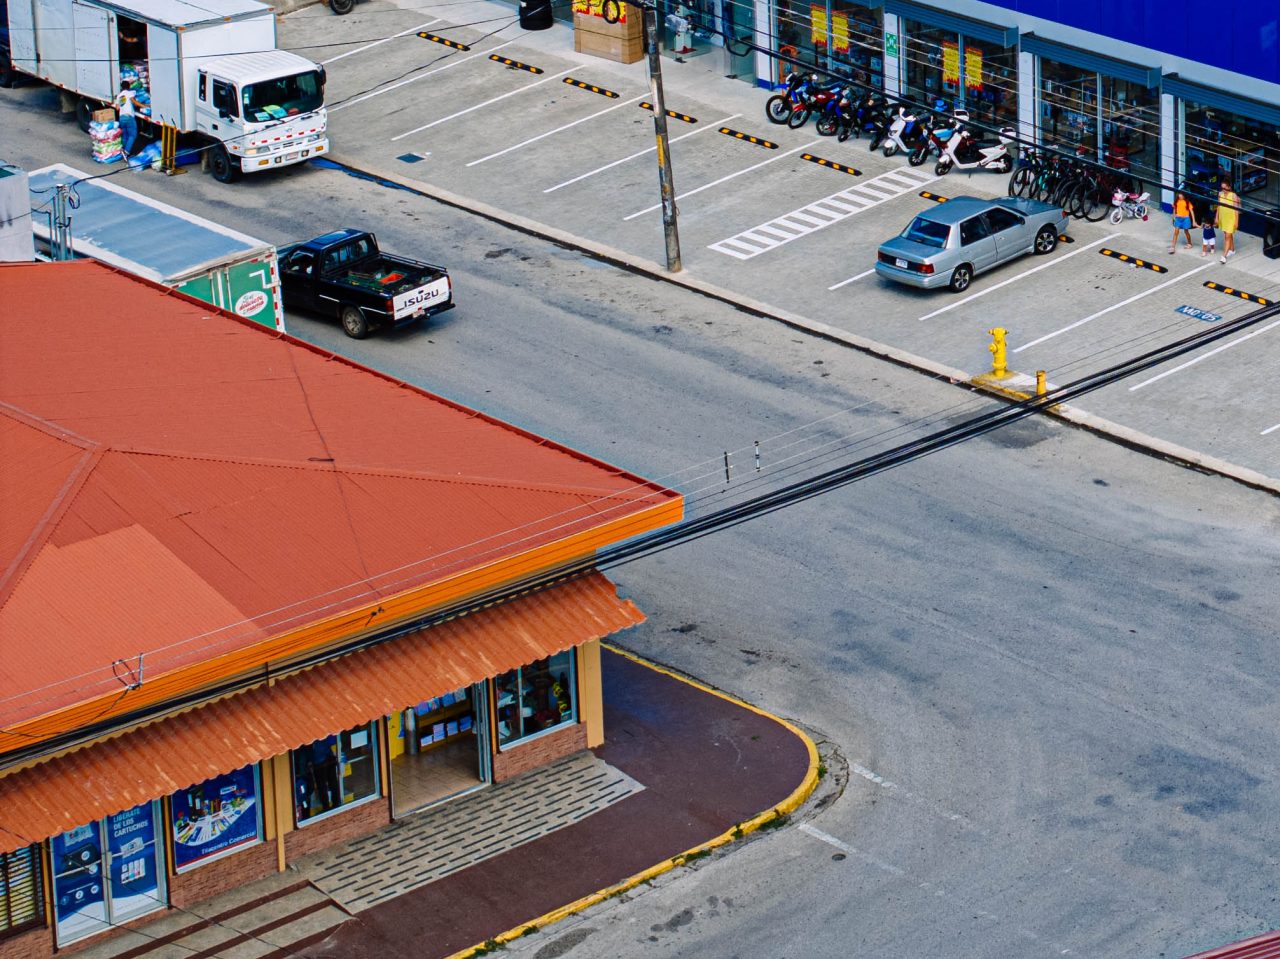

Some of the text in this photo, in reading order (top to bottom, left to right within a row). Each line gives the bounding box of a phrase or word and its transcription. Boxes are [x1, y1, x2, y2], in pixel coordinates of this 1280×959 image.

[404, 289, 439, 308] ISUZU
[113, 818, 134, 830] DE LOS
[114, 820, 149, 838] CARTUCHOS
